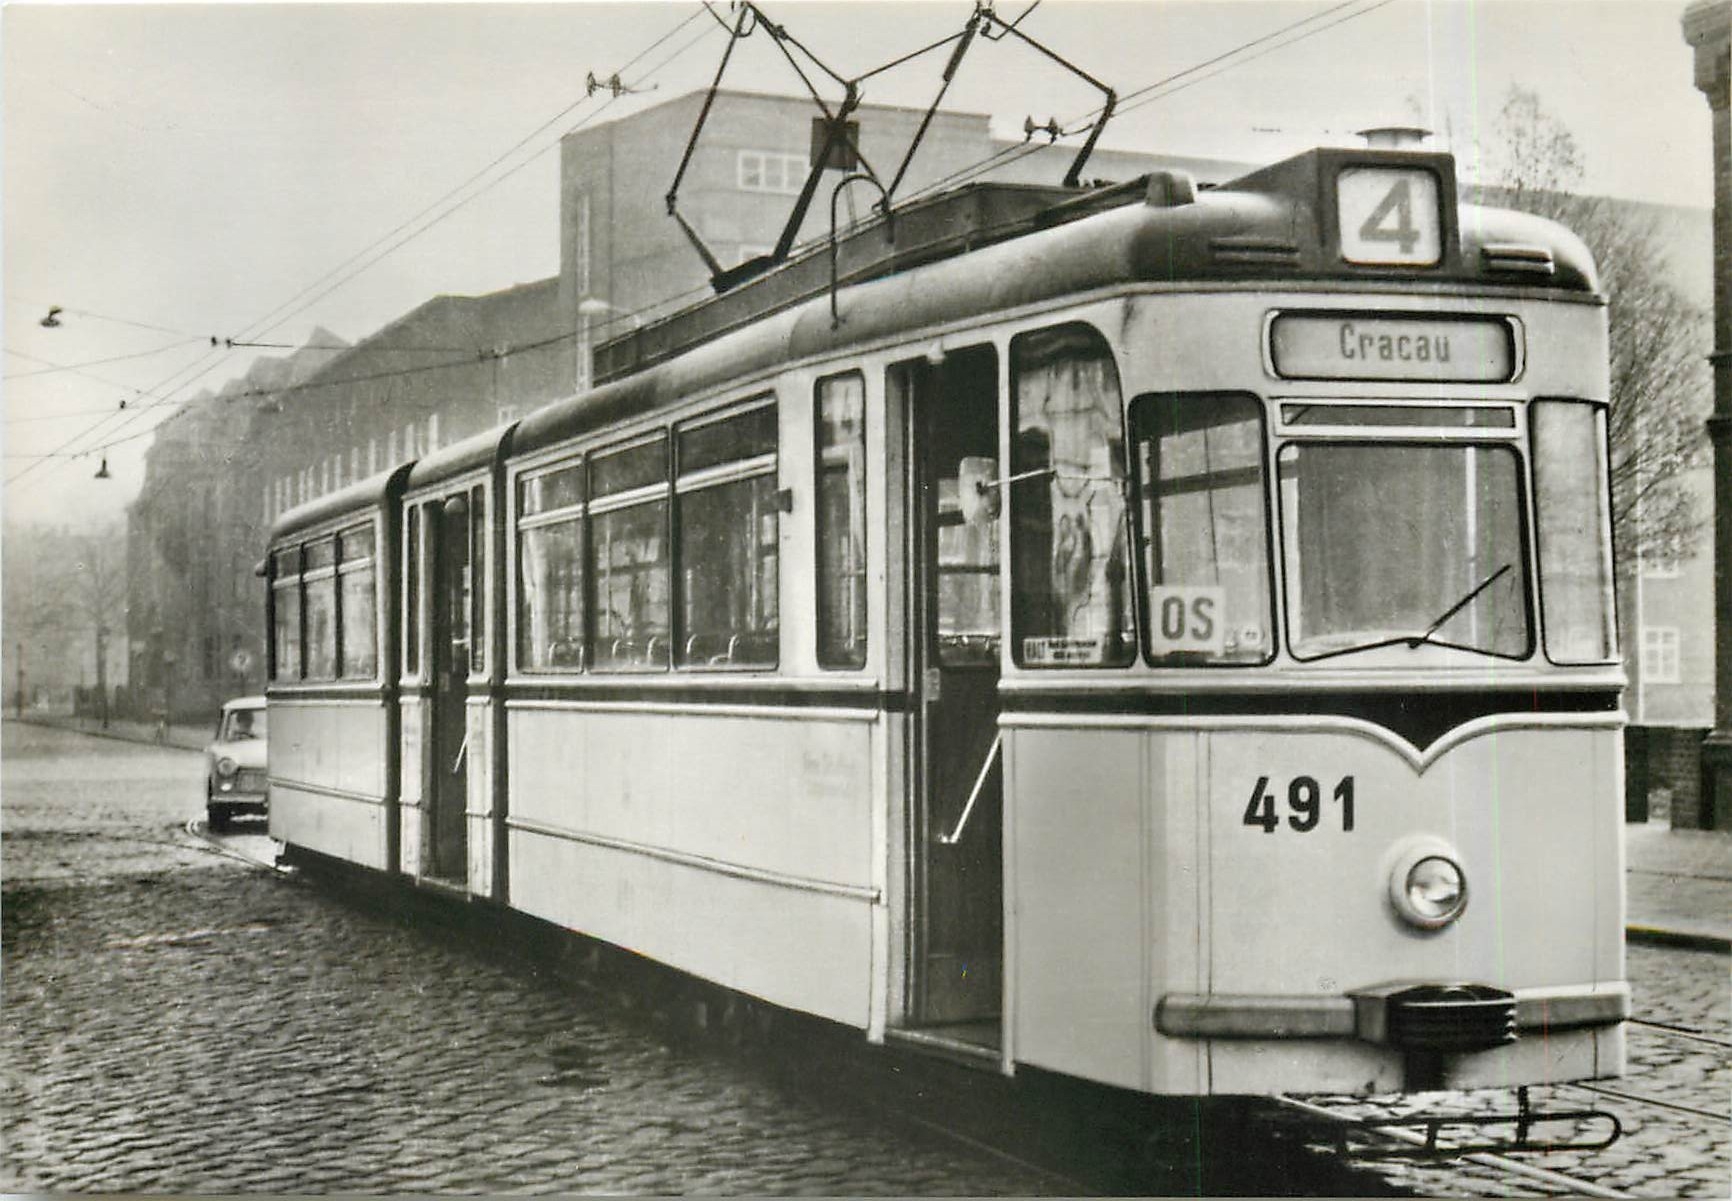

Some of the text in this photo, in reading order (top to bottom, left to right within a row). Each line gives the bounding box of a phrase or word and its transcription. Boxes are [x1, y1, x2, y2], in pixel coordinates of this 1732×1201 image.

[1359, 178, 1421, 255] 4
[1340, 324, 1450, 362] Cracau
[1162, 596, 1214, 641] OS
[1242, 775, 1355, 833] 491
